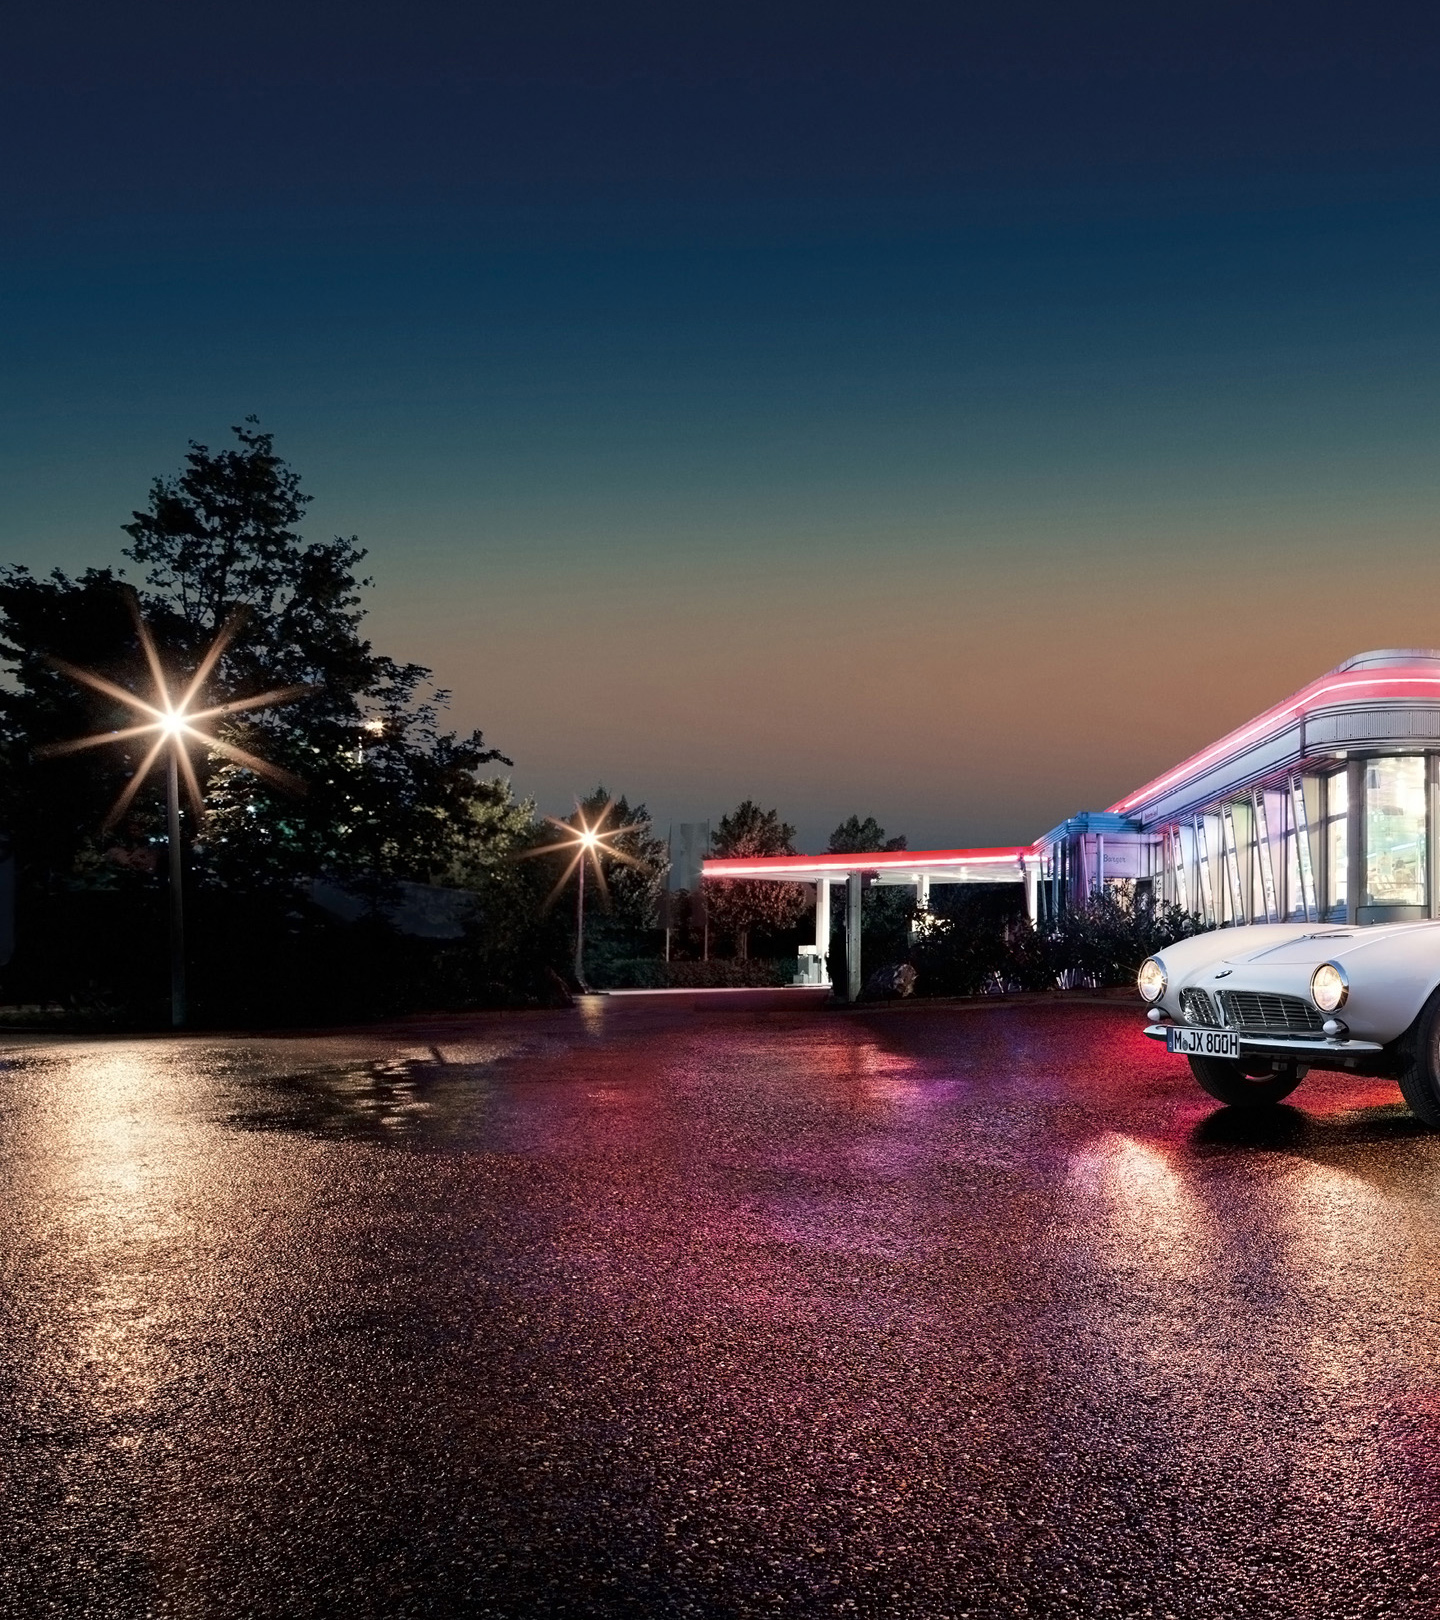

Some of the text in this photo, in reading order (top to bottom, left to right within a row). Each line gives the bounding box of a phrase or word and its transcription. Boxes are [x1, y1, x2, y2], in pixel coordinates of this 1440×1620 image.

[1174, 1031, 1182, 1050] M
[1188, 1032, 1204, 1052] JX
[1206, 1033, 1238, 1055] 800H
